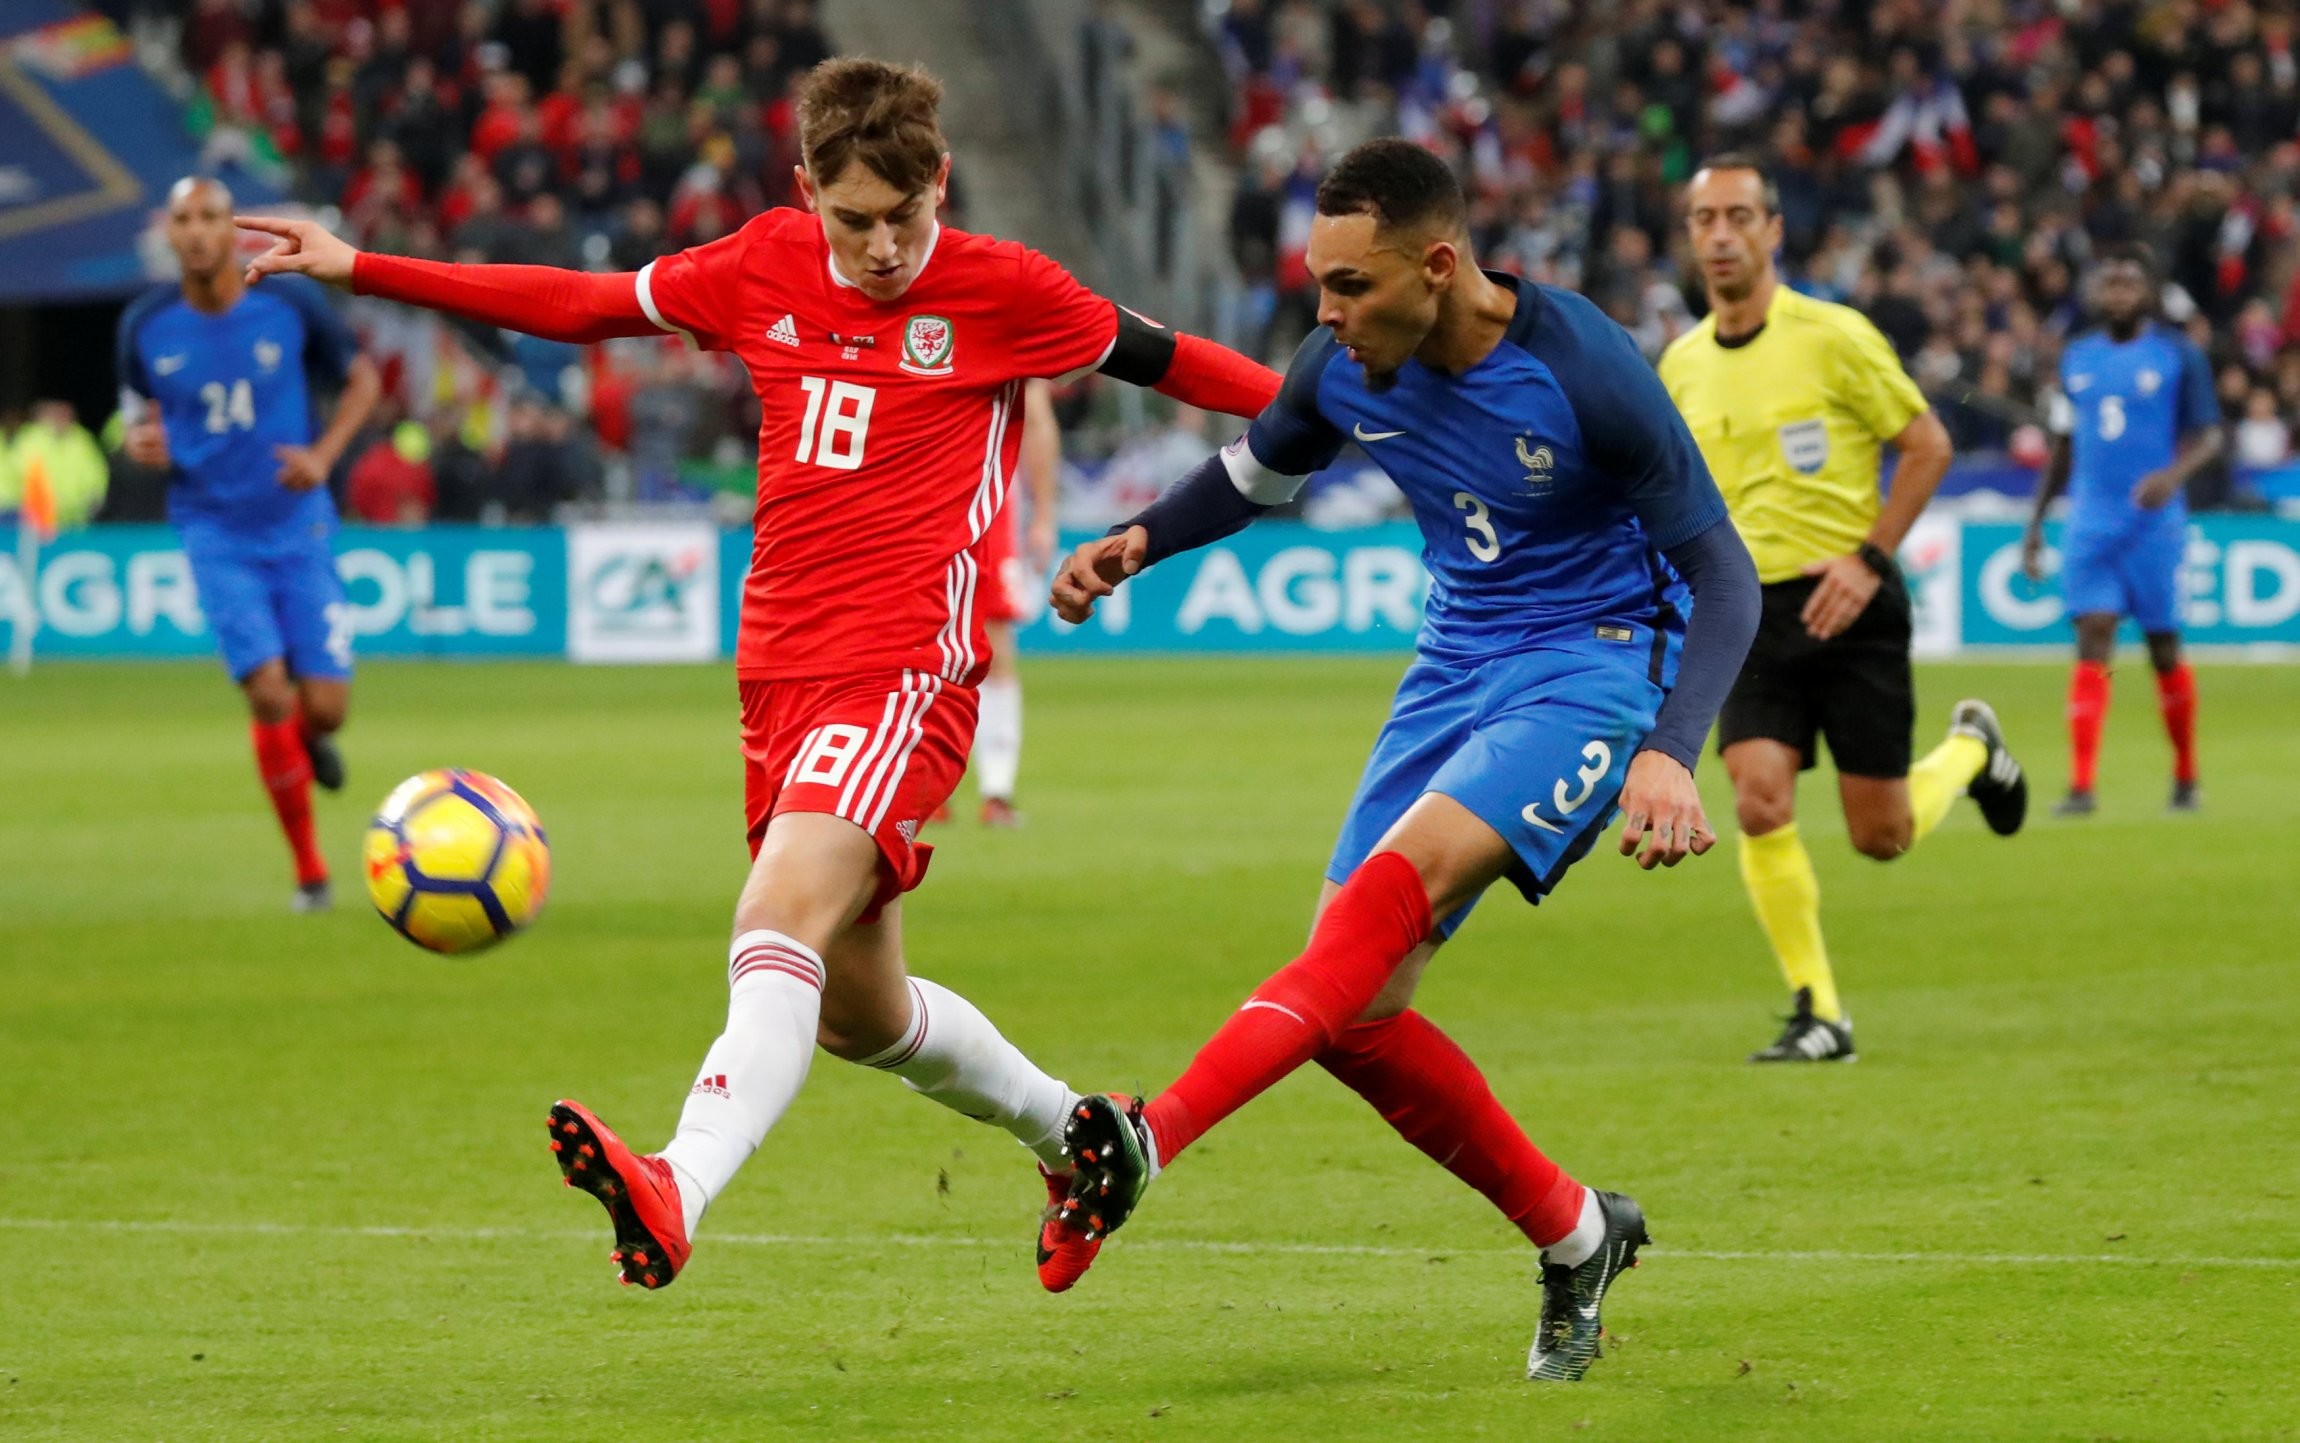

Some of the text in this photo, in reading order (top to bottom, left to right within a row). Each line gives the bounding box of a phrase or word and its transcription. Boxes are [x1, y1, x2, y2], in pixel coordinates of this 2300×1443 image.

[766, 329, 800, 347] adidas
[200, 379, 254, 433] 24
[795, 375, 877, 470] 18
[1453, 491, 1501, 563] 3
[1174, 545, 1432, 635] AGR
[781, 723, 869, 792] 18
[1553, 740, 1612, 815] 3
